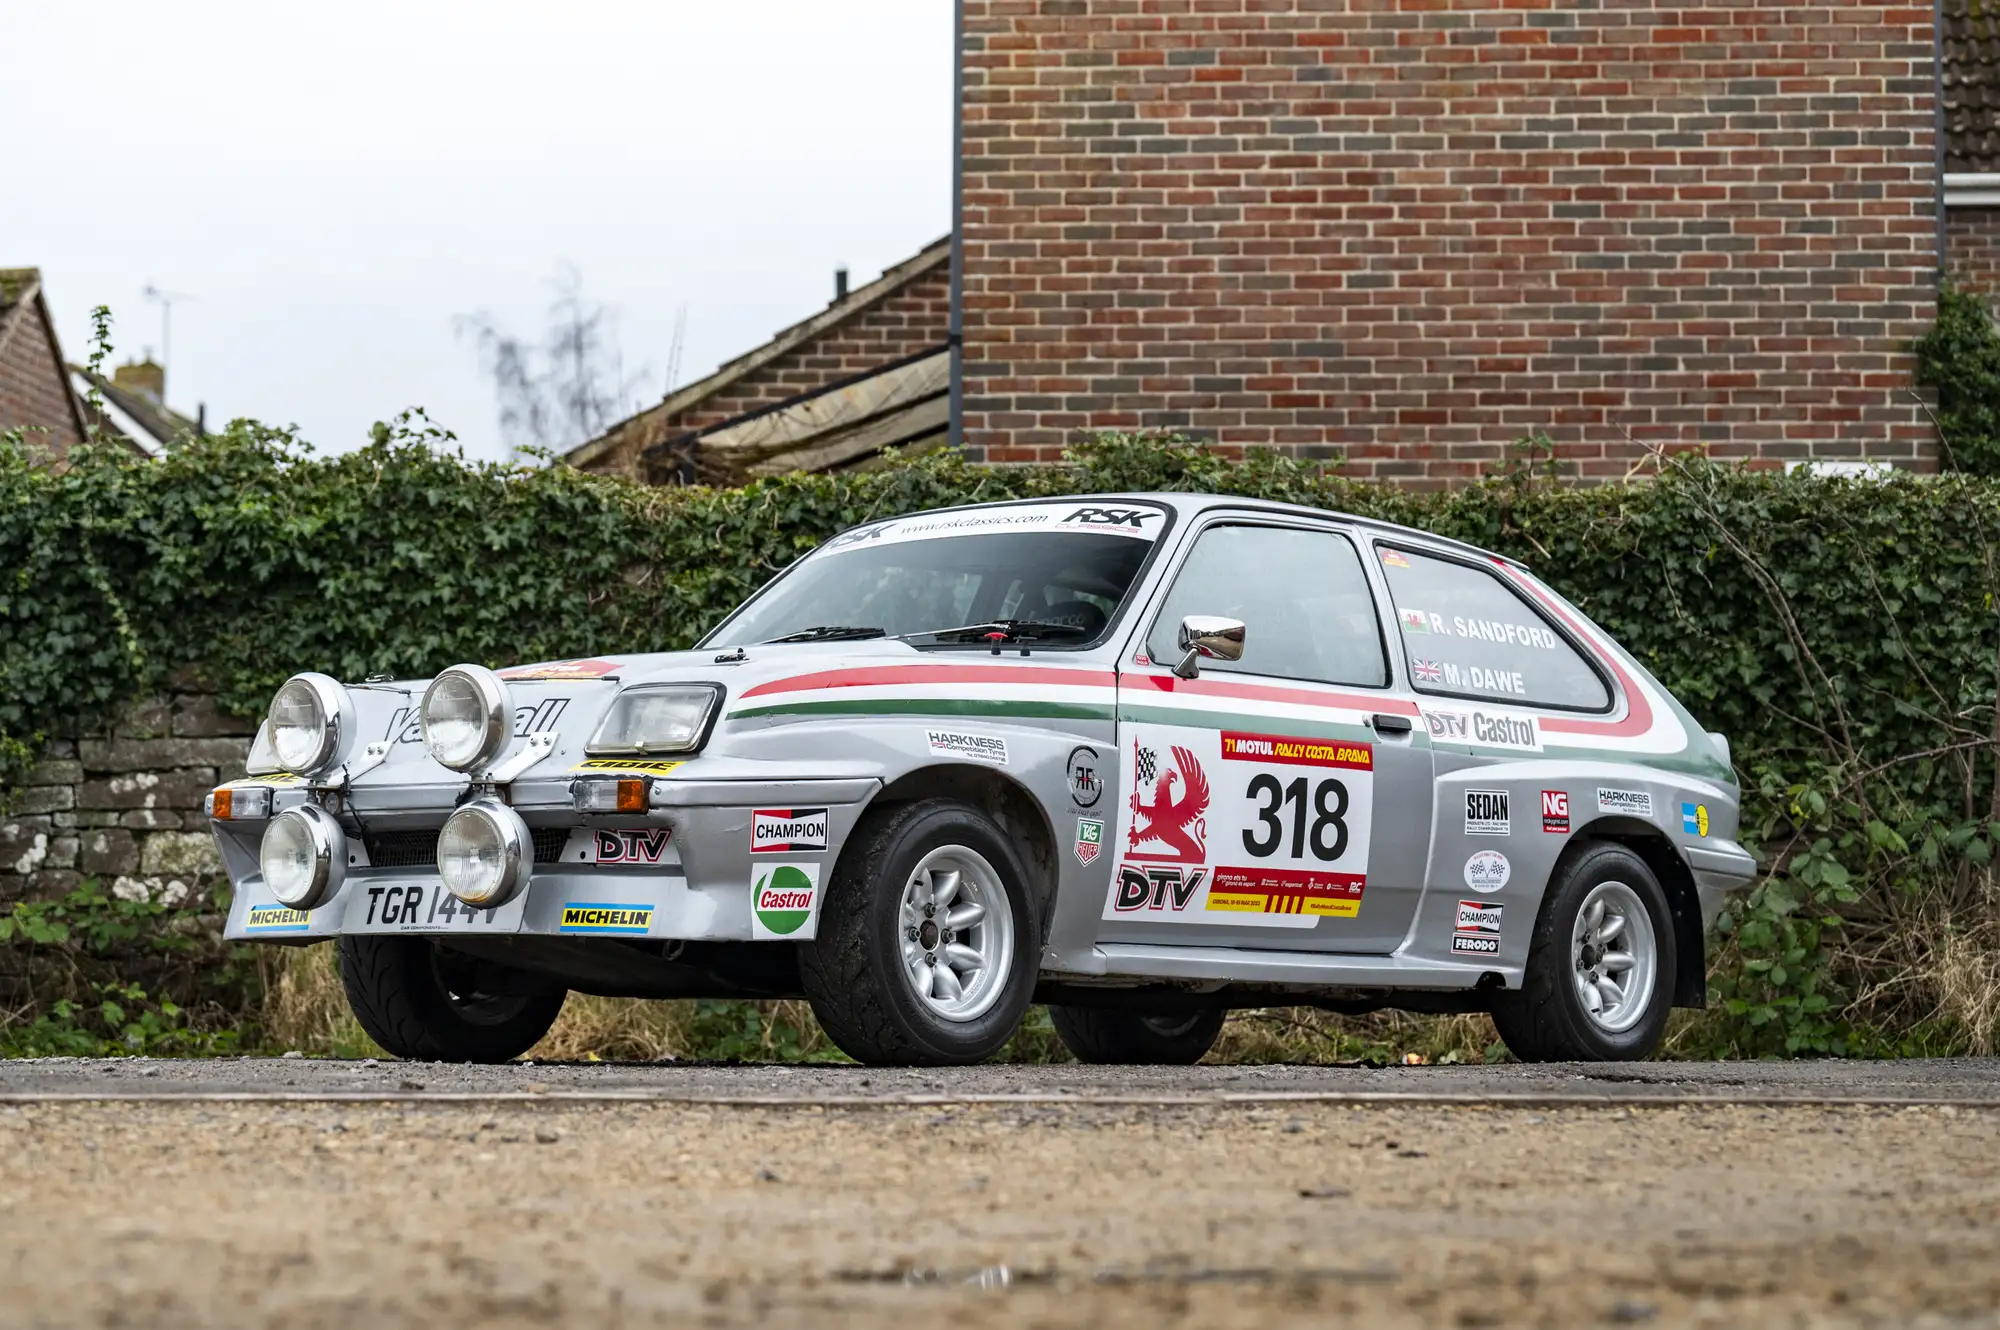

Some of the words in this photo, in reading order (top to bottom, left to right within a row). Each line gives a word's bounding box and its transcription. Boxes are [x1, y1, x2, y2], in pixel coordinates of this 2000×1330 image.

[901, 514, 1048, 535] www.rskclassics.com
[1061, 507, 1163, 528] RSK
[1054, 523, 1141, 534] CLASSICS
[1429, 612, 1451, 635] R.
[1453, 616, 1556, 649] SANDFORD
[1442, 662, 1468, 687] M.
[1469, 666, 1526, 694] DAWE
[1423, 711, 1469, 738] DTV
[1473, 711, 1536, 746] Castrol
[928, 732, 1005, 750] HARKNESS
[946, 743, 988, 753] Competition
[988, 747, 1006, 757] Tyres
[1224, 739, 1236, 752] 71
[1236, 739, 1274, 756] MOTUL
[1274, 742, 1306, 758] RALLY
[1305, 745, 1336, 760] COSTA
[1336, 748, 1370, 763] BRAVA
[580, 761, 676, 770] CIBIE
[1543, 792, 1568, 816] NG
[1599, 790, 1650, 804] HARKNESS
[1609, 799, 1638, 808] Competition
[1638, 802, 1650, 810] Tyres
[1467, 793, 1508, 821] SEDAN
[1242, 773, 1349, 862] 318
[756, 823, 824, 839] CHAMPION
[1082, 824, 1099, 841] TAG
[594, 829, 670, 861] DTV
[1078, 845, 1099, 861] HEUER
[1116, 866, 1206, 910] DTV
[366, 886, 424, 925] TGR
[760, 890, 814, 909] Castrol
[248, 910, 310, 925] MICHELIN
[564, 910, 648, 925] MICHELIN
[1460, 911, 1500, 924] CHAMPION
[1455, 938, 1496, 951] FERODO
